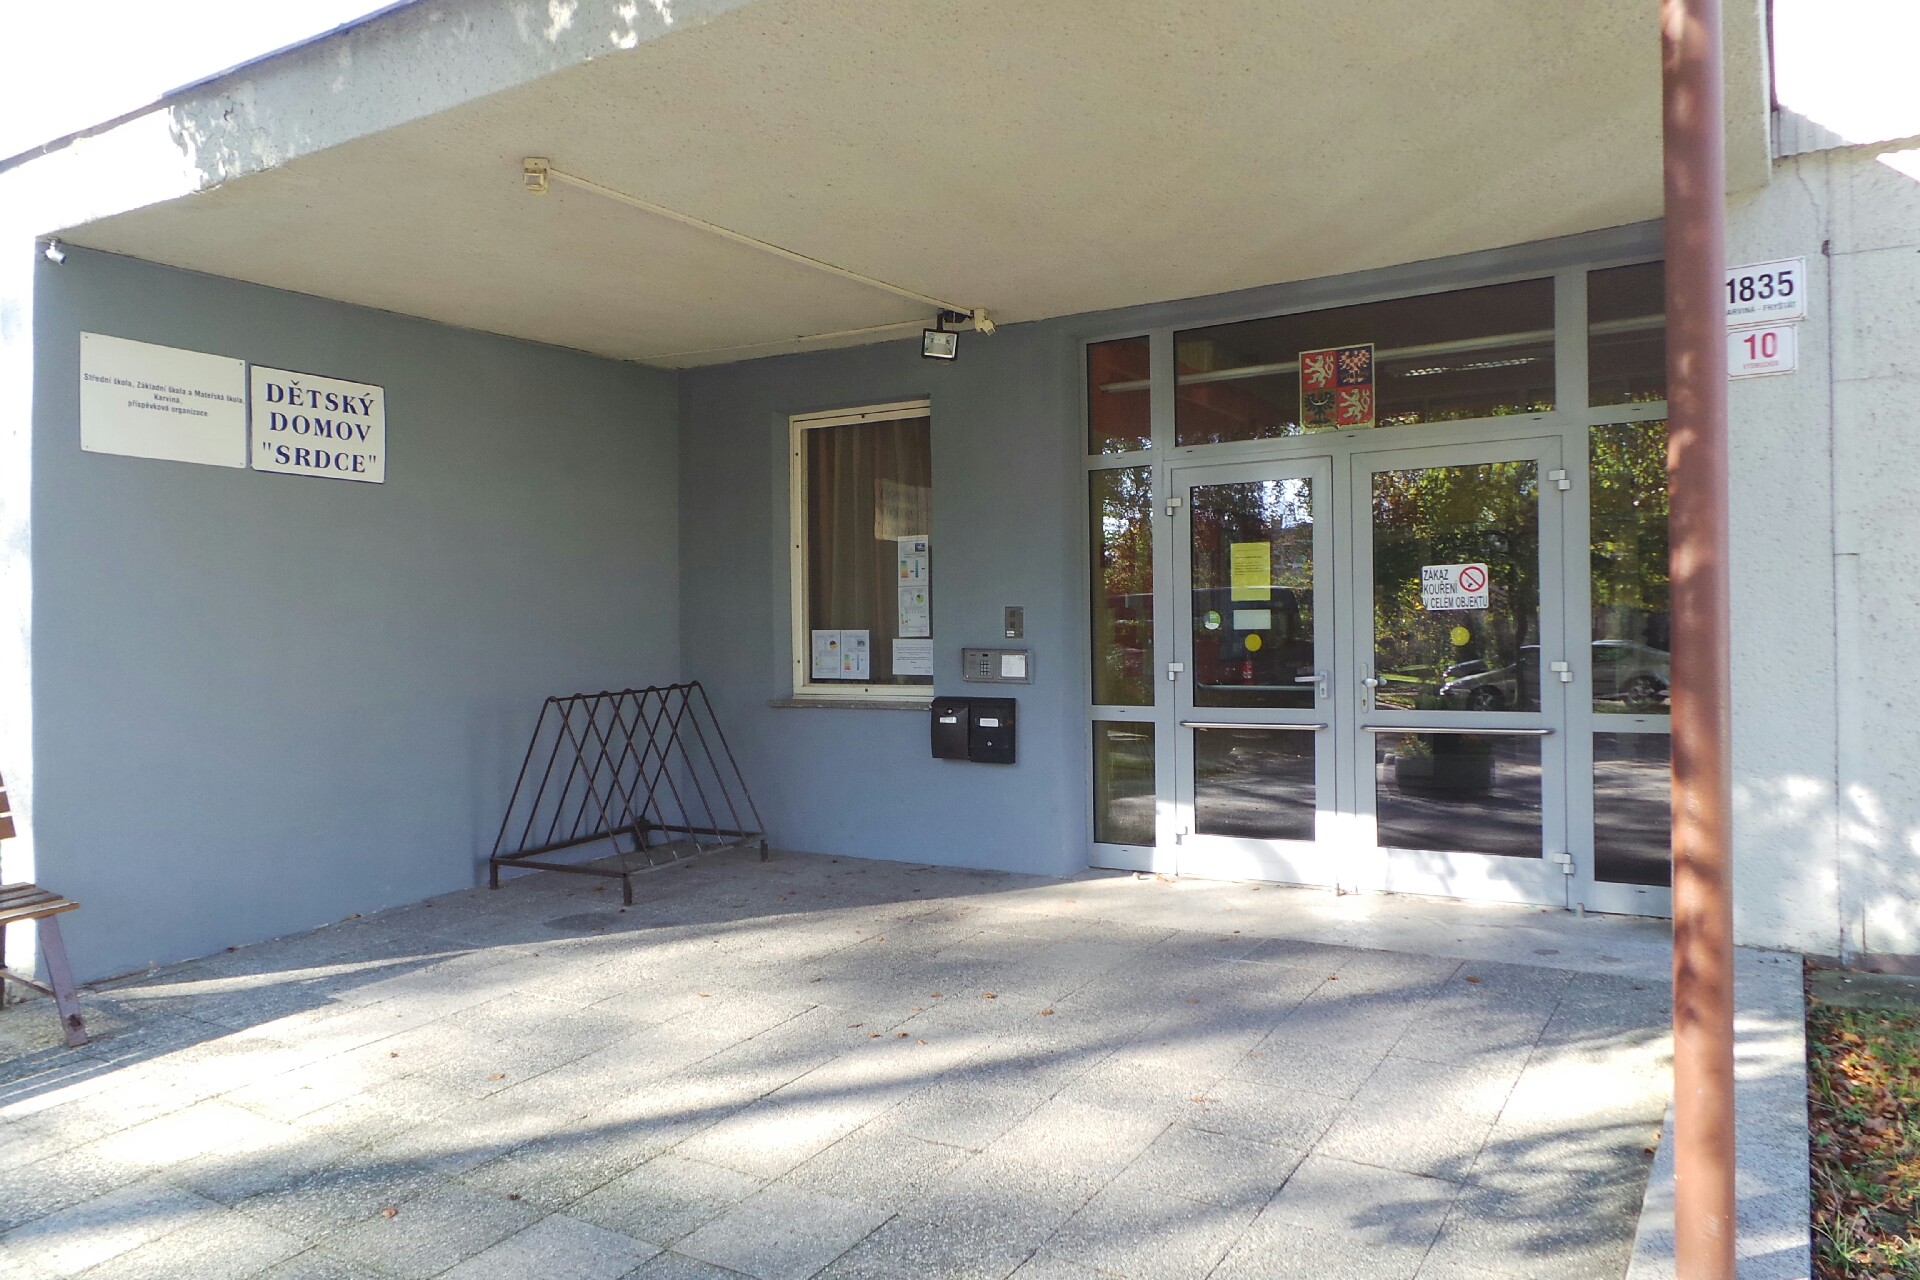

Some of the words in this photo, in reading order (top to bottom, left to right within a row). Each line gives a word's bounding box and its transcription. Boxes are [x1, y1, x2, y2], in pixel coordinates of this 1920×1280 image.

[1725, 270, 1794, 304] 1835
[1743, 332, 1778, 360] 10
[83, 372, 112, 384] Střední
[113, 376, 135, 389] škola,
[136, 381, 167, 392] Základní
[168, 385, 186, 395] škola
[194, 389, 225, 401] Mateřská
[265, 379, 375, 417] DĚTSKÝ
[127, 399, 169, 412] příspěvková
[171, 406, 208, 417] organizace
[269, 411, 372, 443] DOMOV
[262, 441, 377, 473] "SRDCE"
[1423, 567, 1449, 581] ZÁKAZ
[1423, 580, 1458, 595] KOUŘENÍ
[1423, 597, 1430, 608] V
[1455, 595, 1488, 608] OBJEKTU
